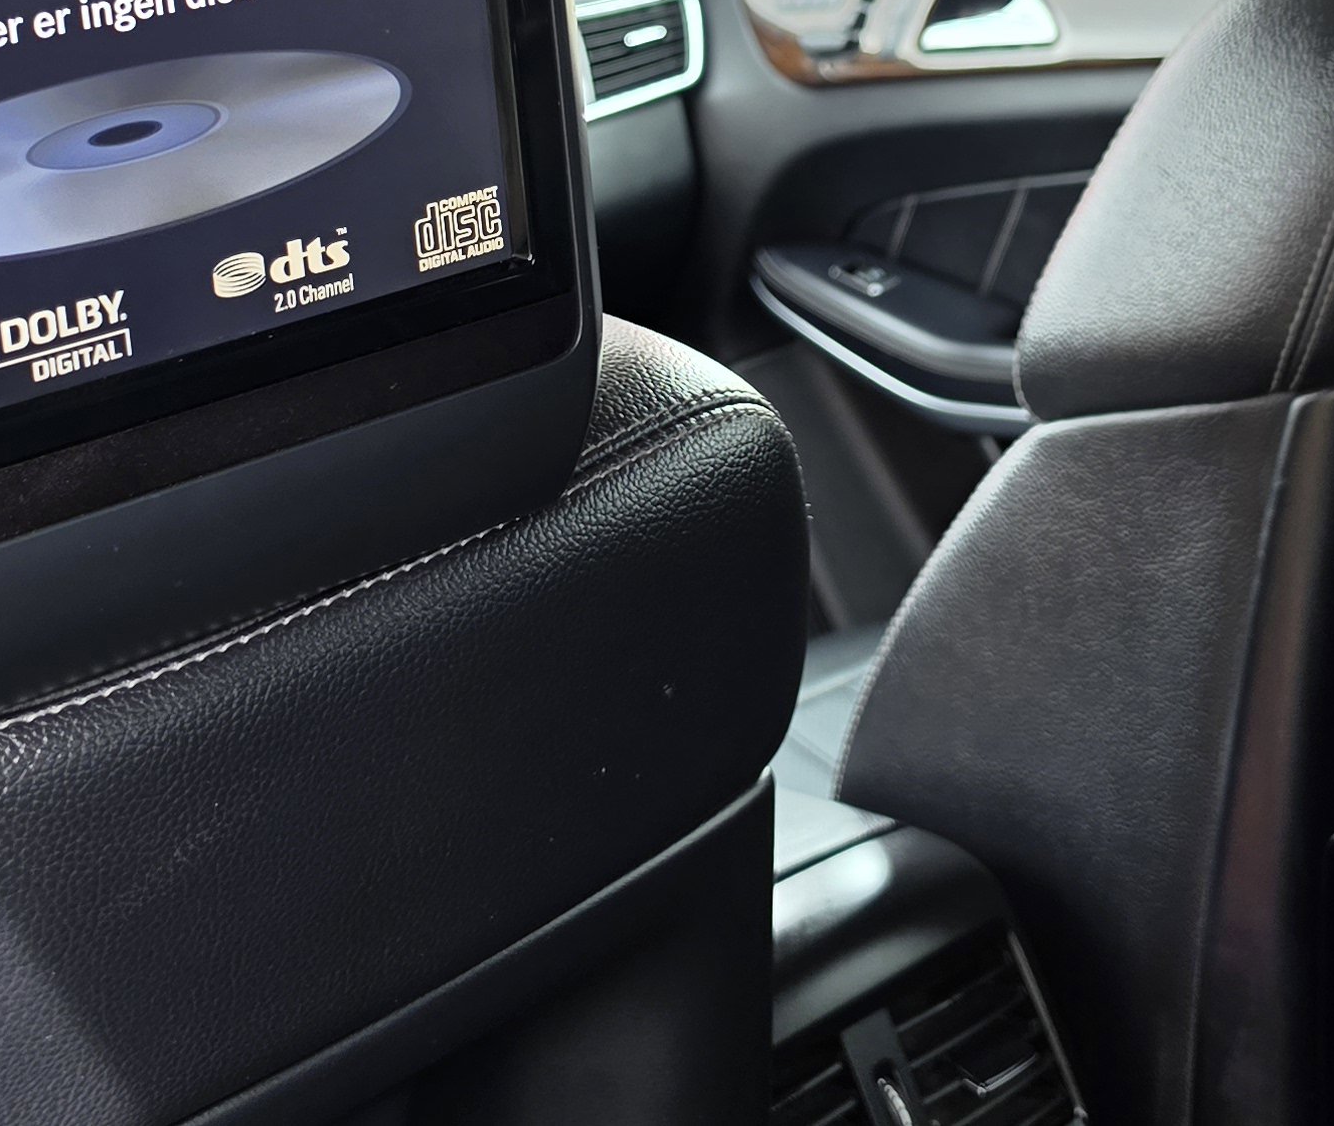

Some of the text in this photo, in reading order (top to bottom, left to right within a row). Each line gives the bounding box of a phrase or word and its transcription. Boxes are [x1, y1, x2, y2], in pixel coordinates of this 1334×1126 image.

[33, 7, 71, 39] er
[439, 185, 498, 212] COMPACT
[269, 236, 351, 284] dts
[418, 236, 504, 272] DIGITAL AUDIO
[274, 273, 355, 313] 2.0 Channel
[32, 340, 123, 382] DIGITAL
